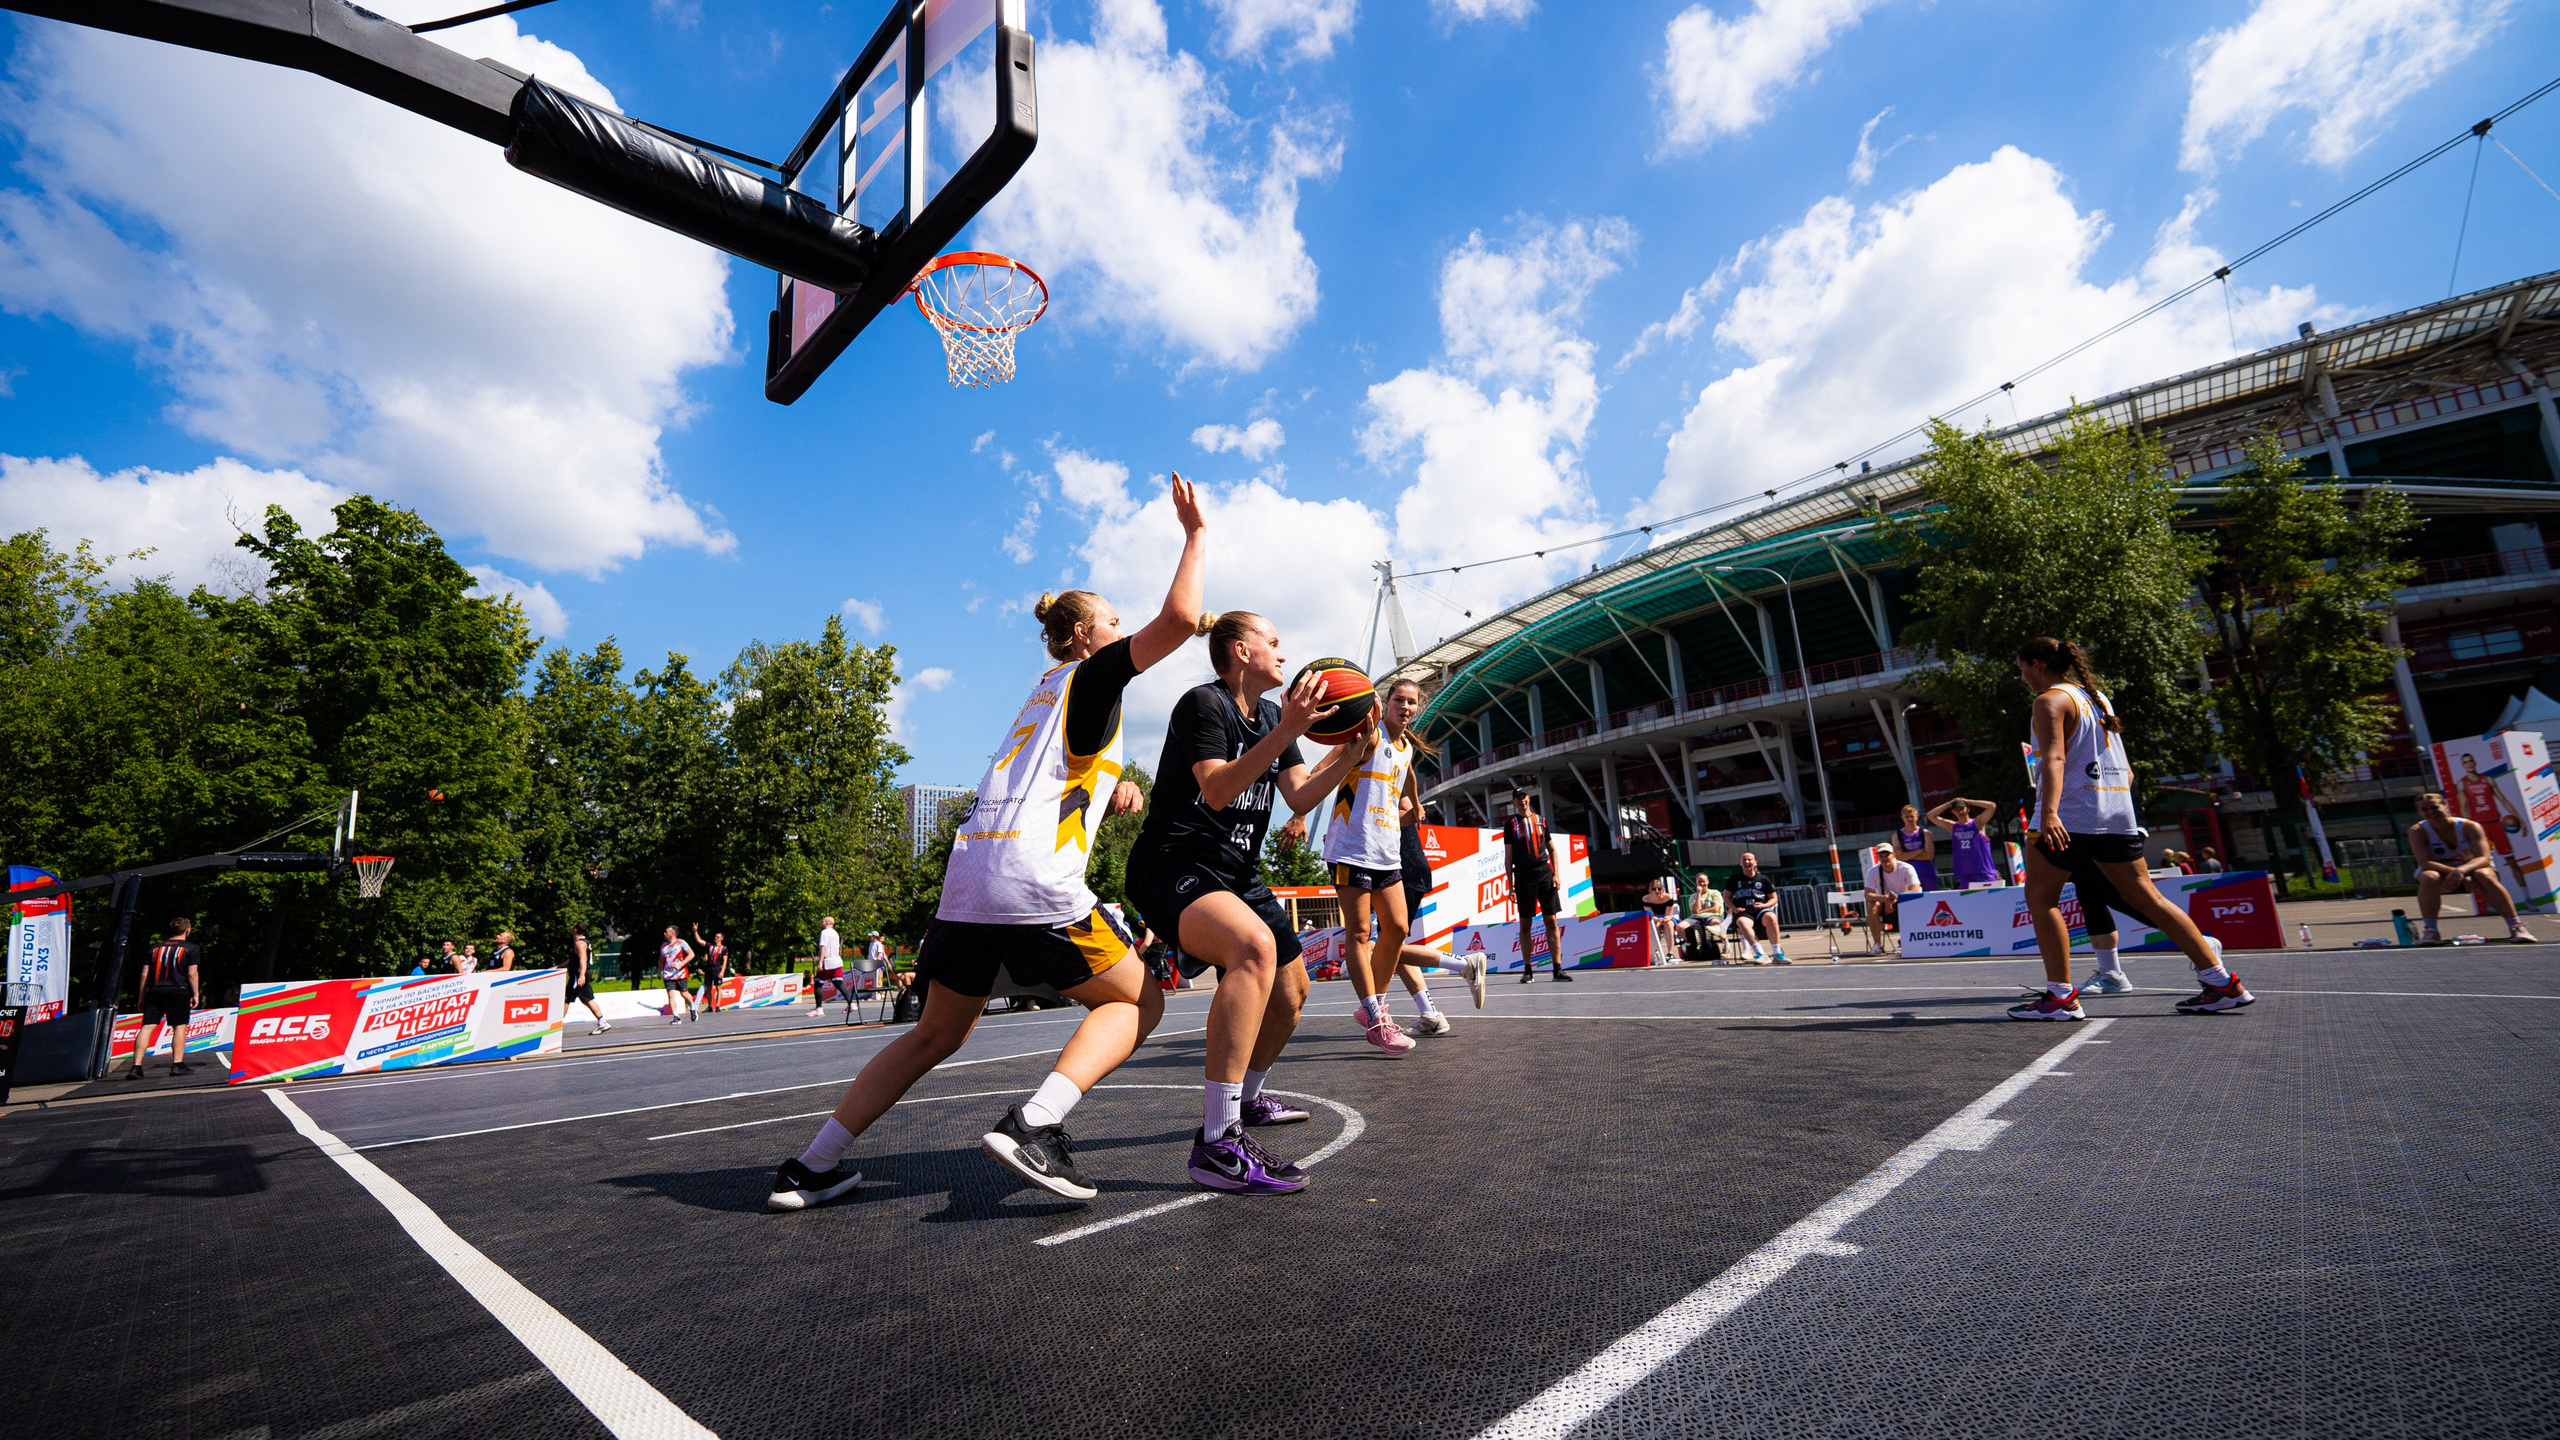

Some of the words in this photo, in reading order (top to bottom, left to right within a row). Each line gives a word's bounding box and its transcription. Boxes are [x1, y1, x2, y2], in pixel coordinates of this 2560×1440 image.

[995, 722, 1038, 770] 7
[972, 830, 1021, 840] ПЕРВЫМ!
[1961, 840, 1971, 849] 22
[1909, 929, 1984, 942] ЛОКОМОТИВ
[372, 995, 402, 1006] ТУРНИР
[417, 980, 464, 995] БАСКЕТБОЛУ
[398, 997, 423, 1007] КУБОК
[368, 992, 472, 1031] ДОСТИГАЯ
[401, 1007, 467, 1036] ЦЕЛИ!
[250, 1014, 331, 1039] АСБ
[366, 1048, 384, 1056] ЧЕСТЬ
[386, 1043, 399, 1051] ДНЯ
[399, 1026, 463, 1047] ЖЕЛЕЗНОДОРОЖНИКА
[426, 1038, 454, 1050] АВГУСТА
